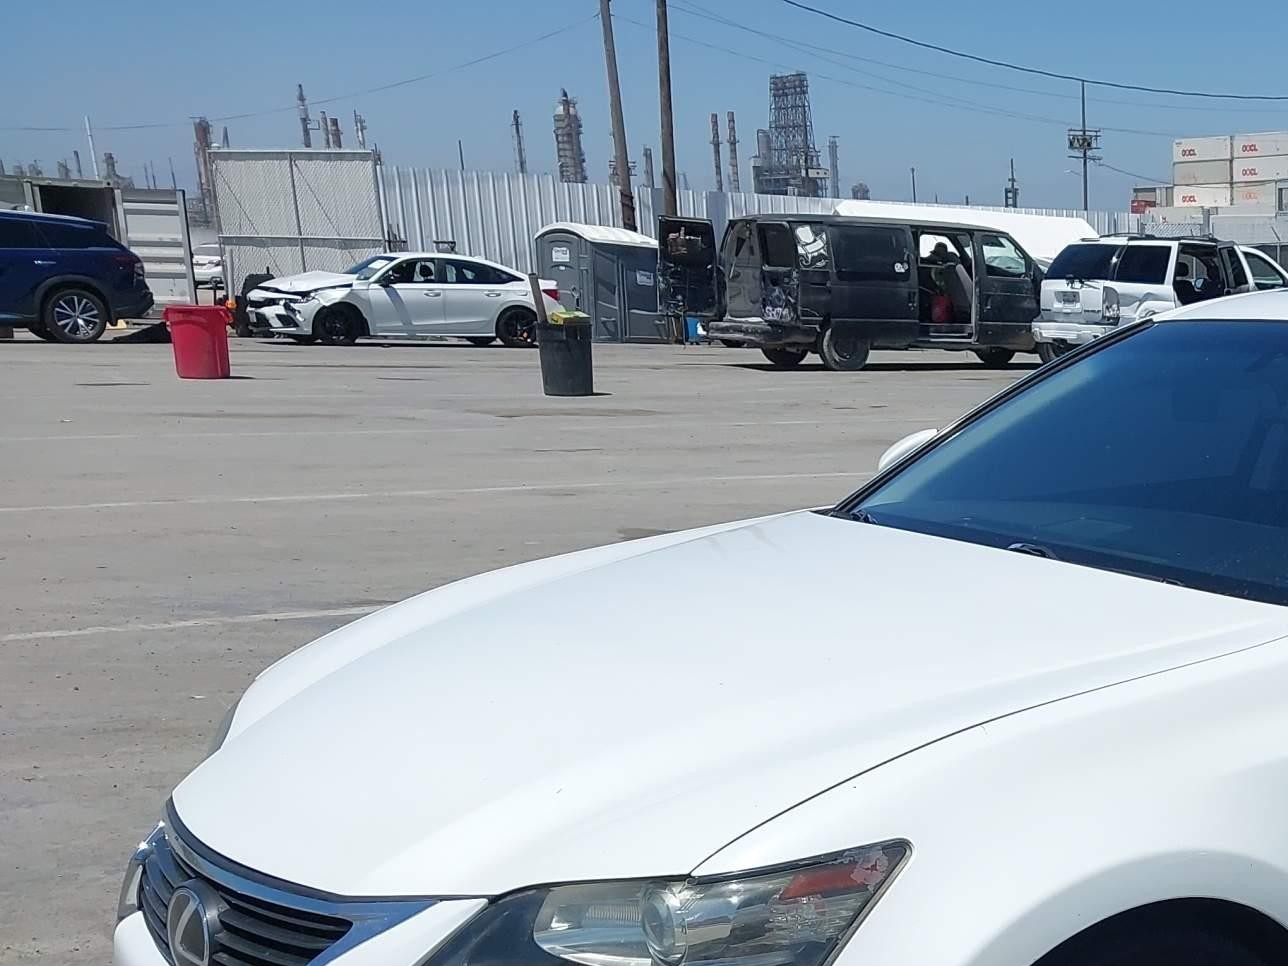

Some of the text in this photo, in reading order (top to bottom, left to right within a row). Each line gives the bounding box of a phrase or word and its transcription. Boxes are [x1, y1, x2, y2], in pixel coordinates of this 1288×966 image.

[1181, 148, 1197, 157] OOCL
[1242, 144, 1258, 153] OOCL
[1242, 168, 1258, 176] OOCL
